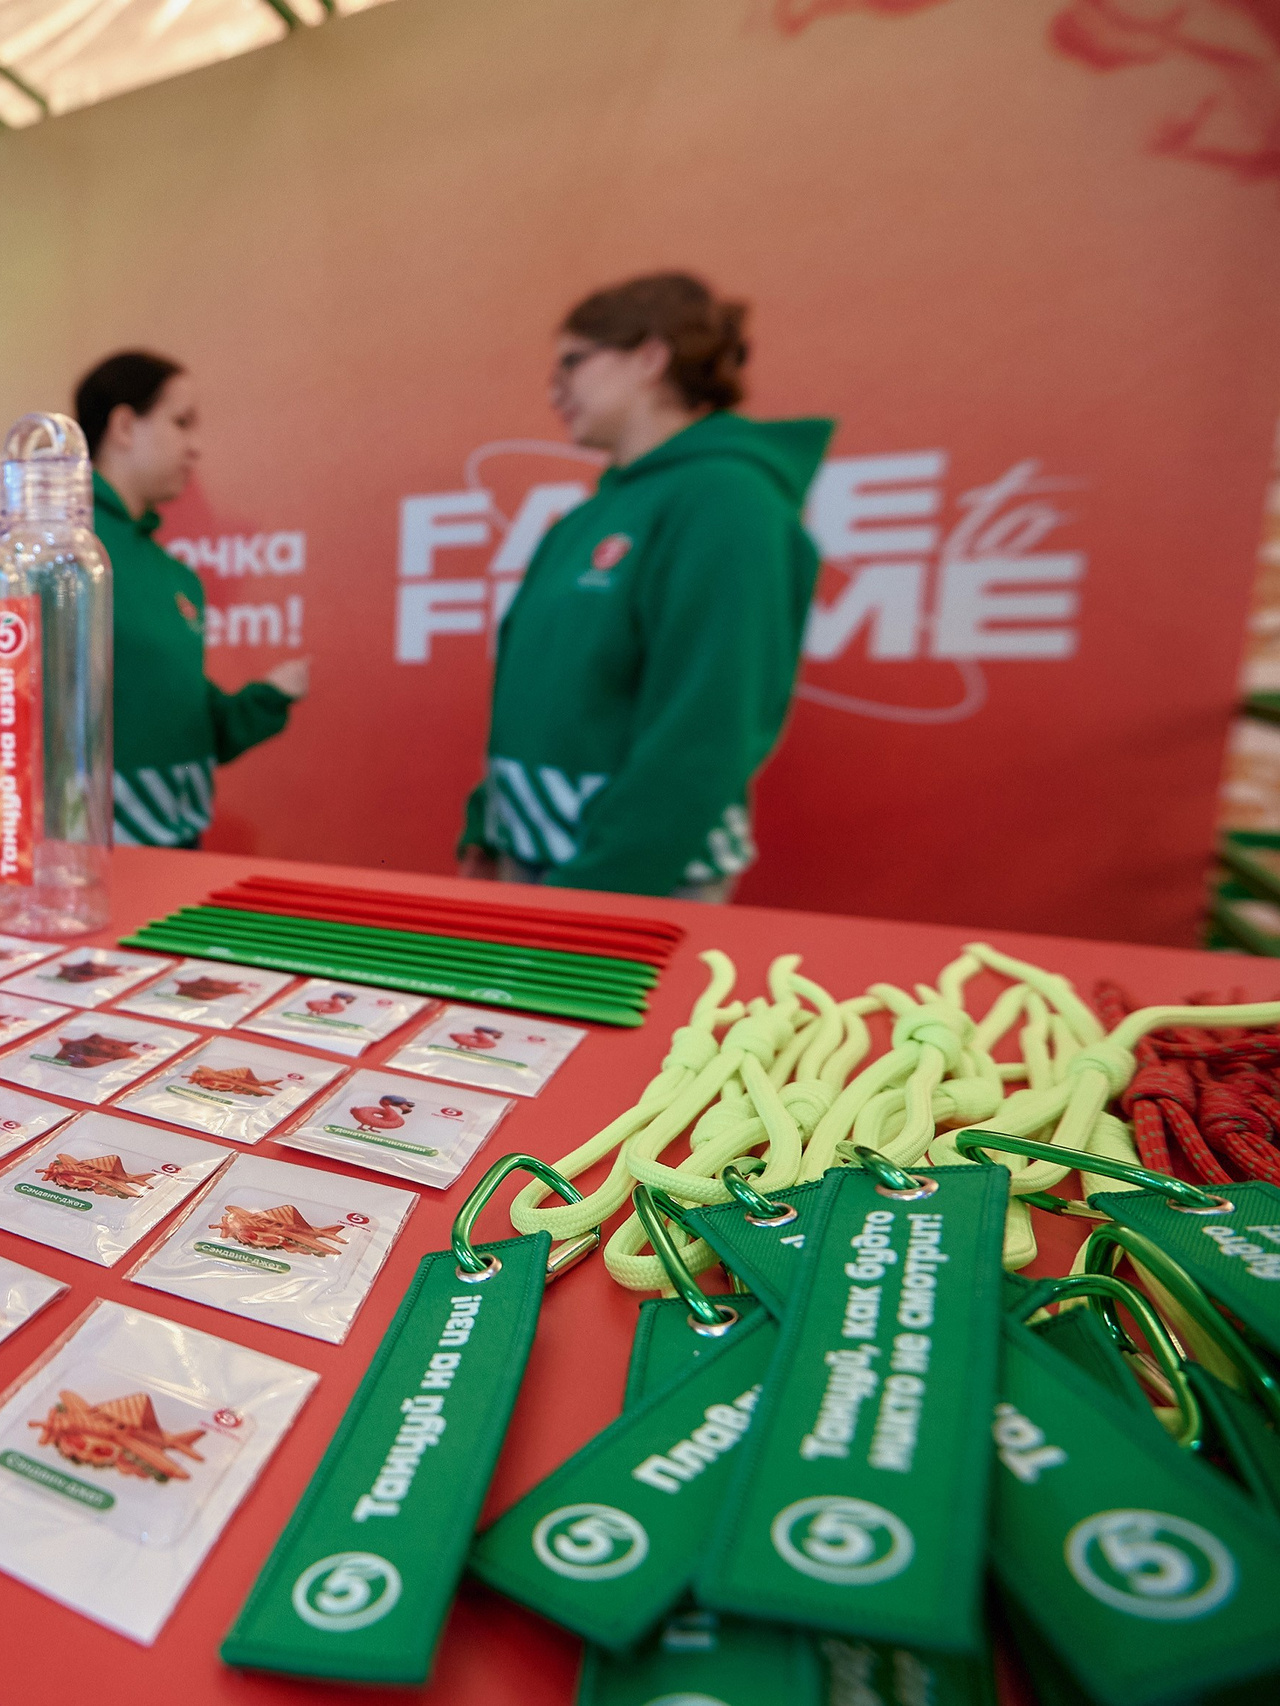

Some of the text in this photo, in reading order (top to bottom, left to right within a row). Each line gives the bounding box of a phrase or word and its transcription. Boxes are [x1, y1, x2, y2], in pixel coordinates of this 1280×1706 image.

[398, 449, 949, 577] FAE
[395, 551, 1088, 665] FME
[0, 731, 17, 769] на
[20, 1184, 87, 1209] Сэндвич-джет
[201, 1244, 284, 1271] Сэндвич-джет
[798, 1209, 899, 1462] Танцуй, как будто
[866, 1212, 951, 1474] никто не смотрит!
[351, 1294, 484, 1523] Танцуй на изи!
